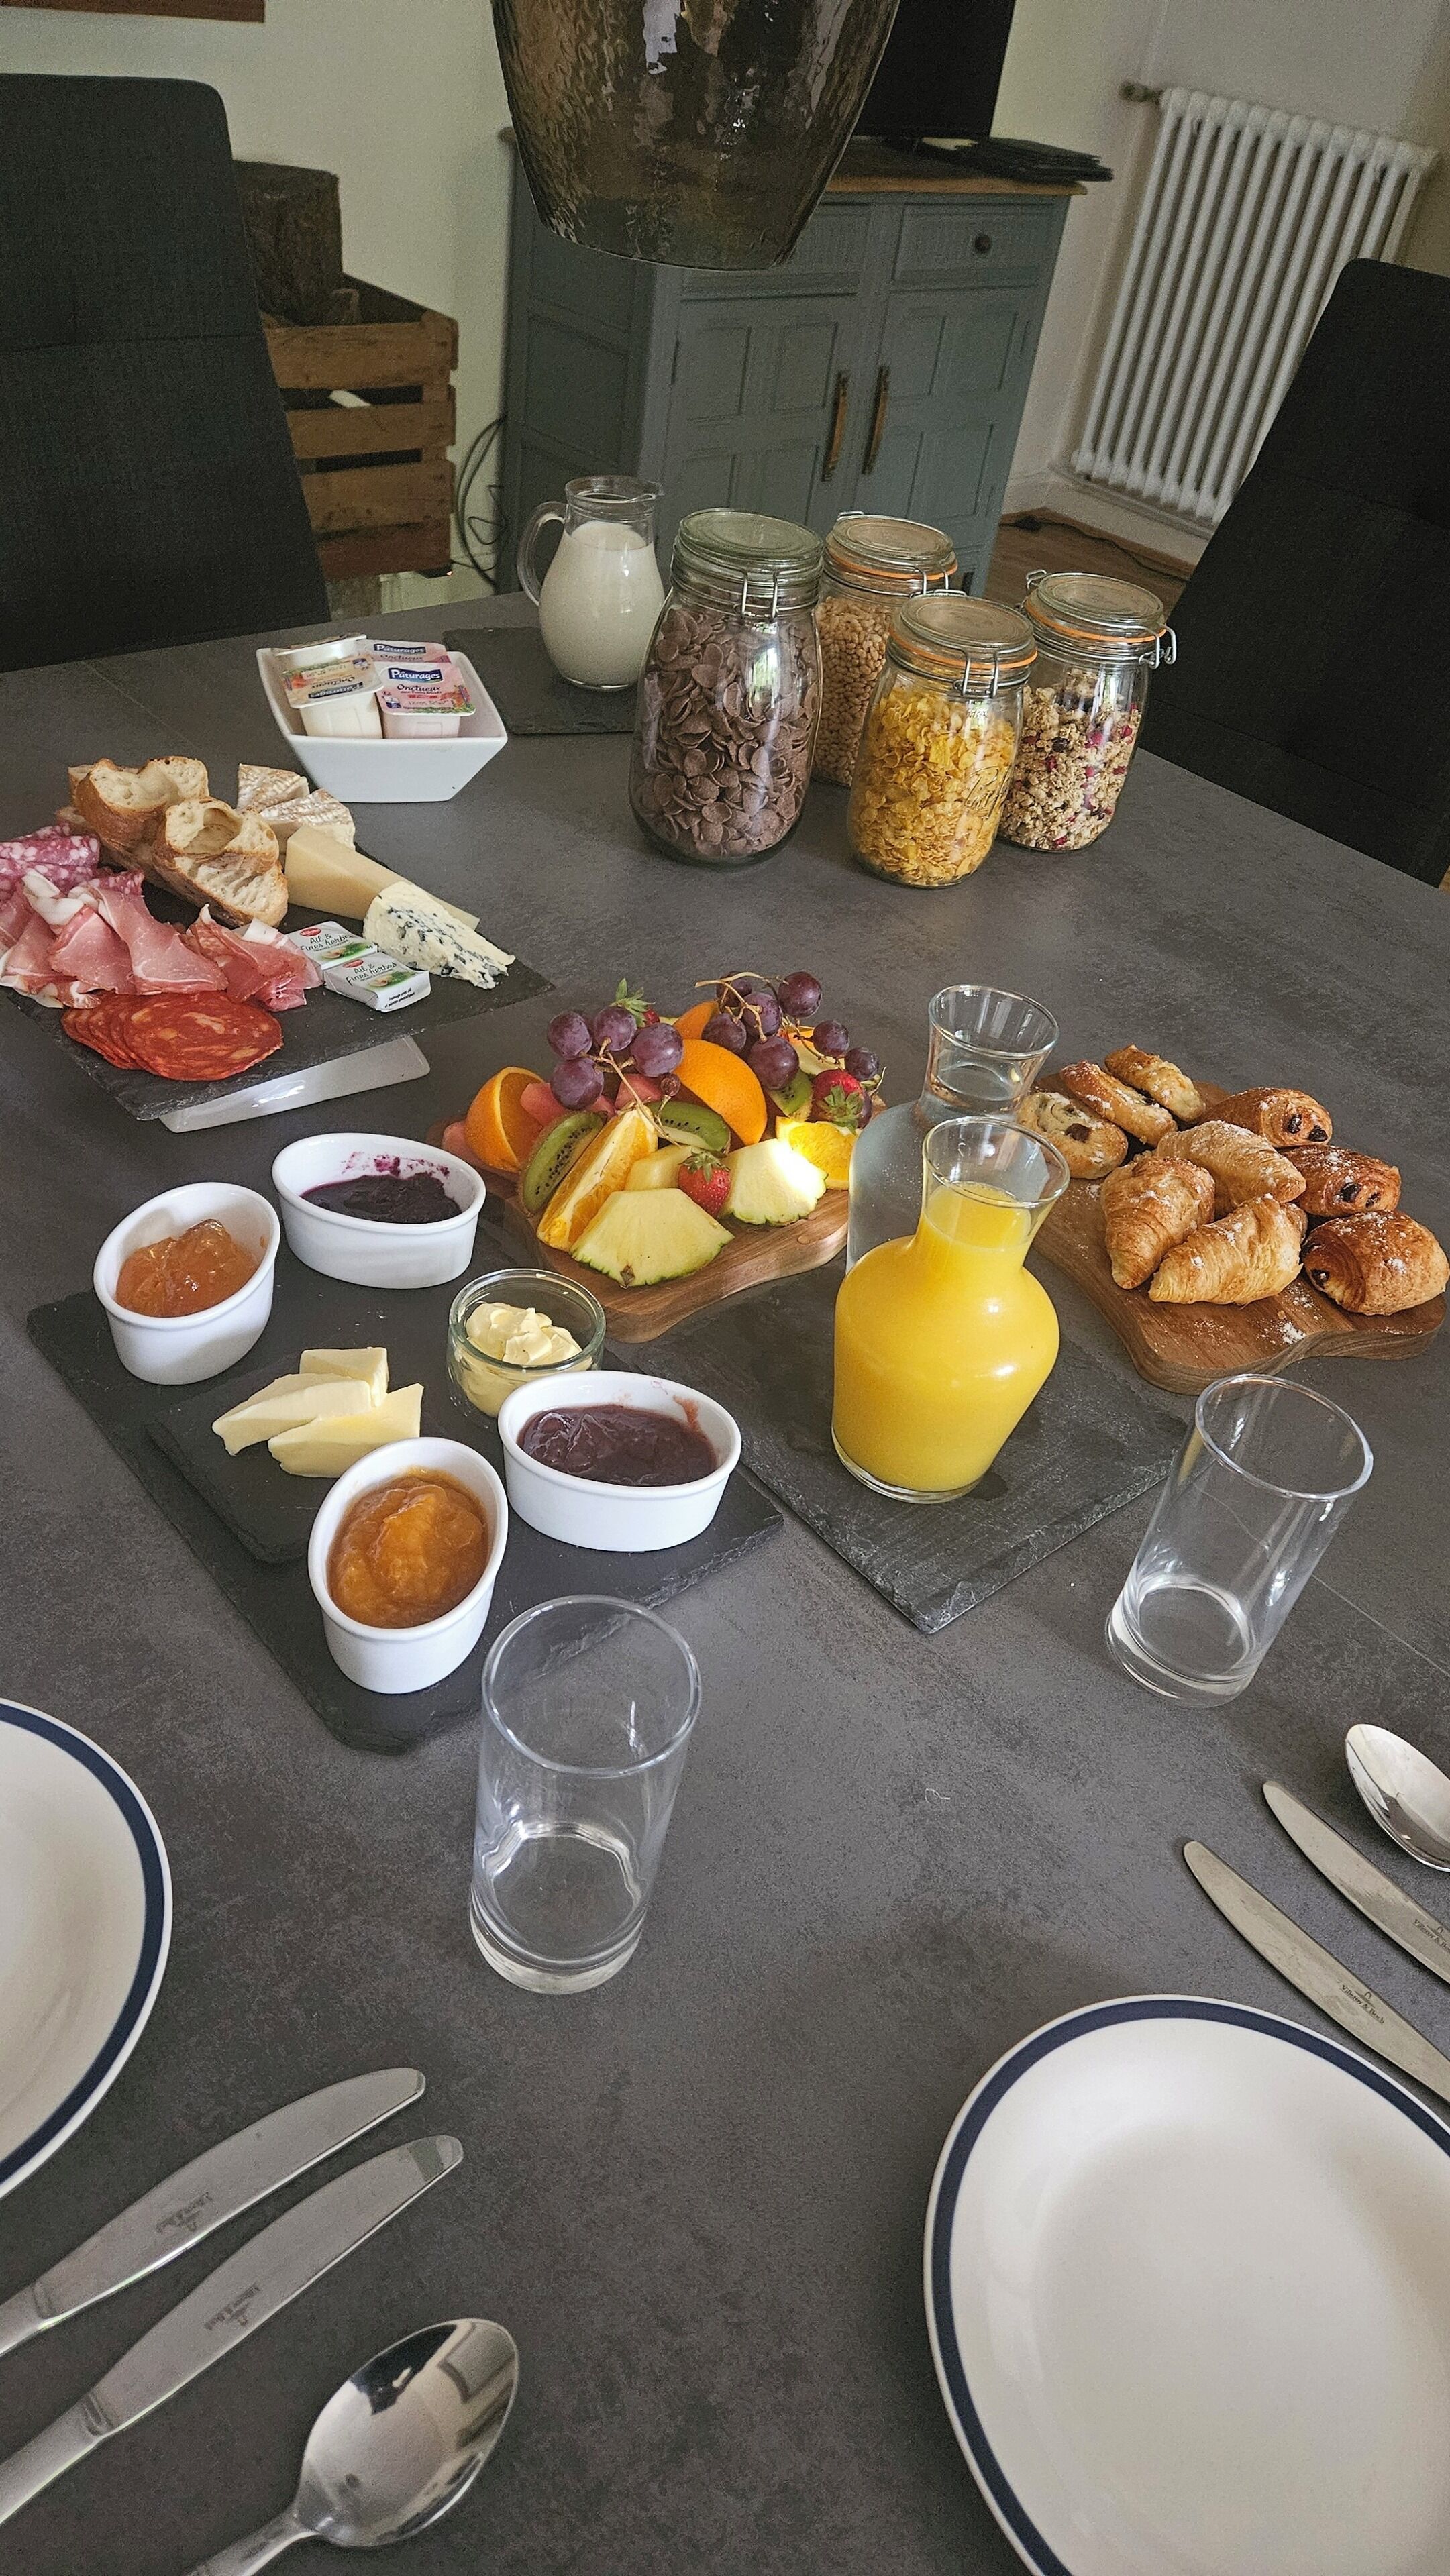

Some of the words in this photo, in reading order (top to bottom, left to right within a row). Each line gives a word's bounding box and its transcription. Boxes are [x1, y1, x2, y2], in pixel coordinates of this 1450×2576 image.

[391, 669, 441, 681] Pâturages
[397, 684, 441, 692] Onctueux
[346, 973, 368, 987] Fines
[369, 961, 397, 975] herbes
[354, 966, 367, 974] Ail
